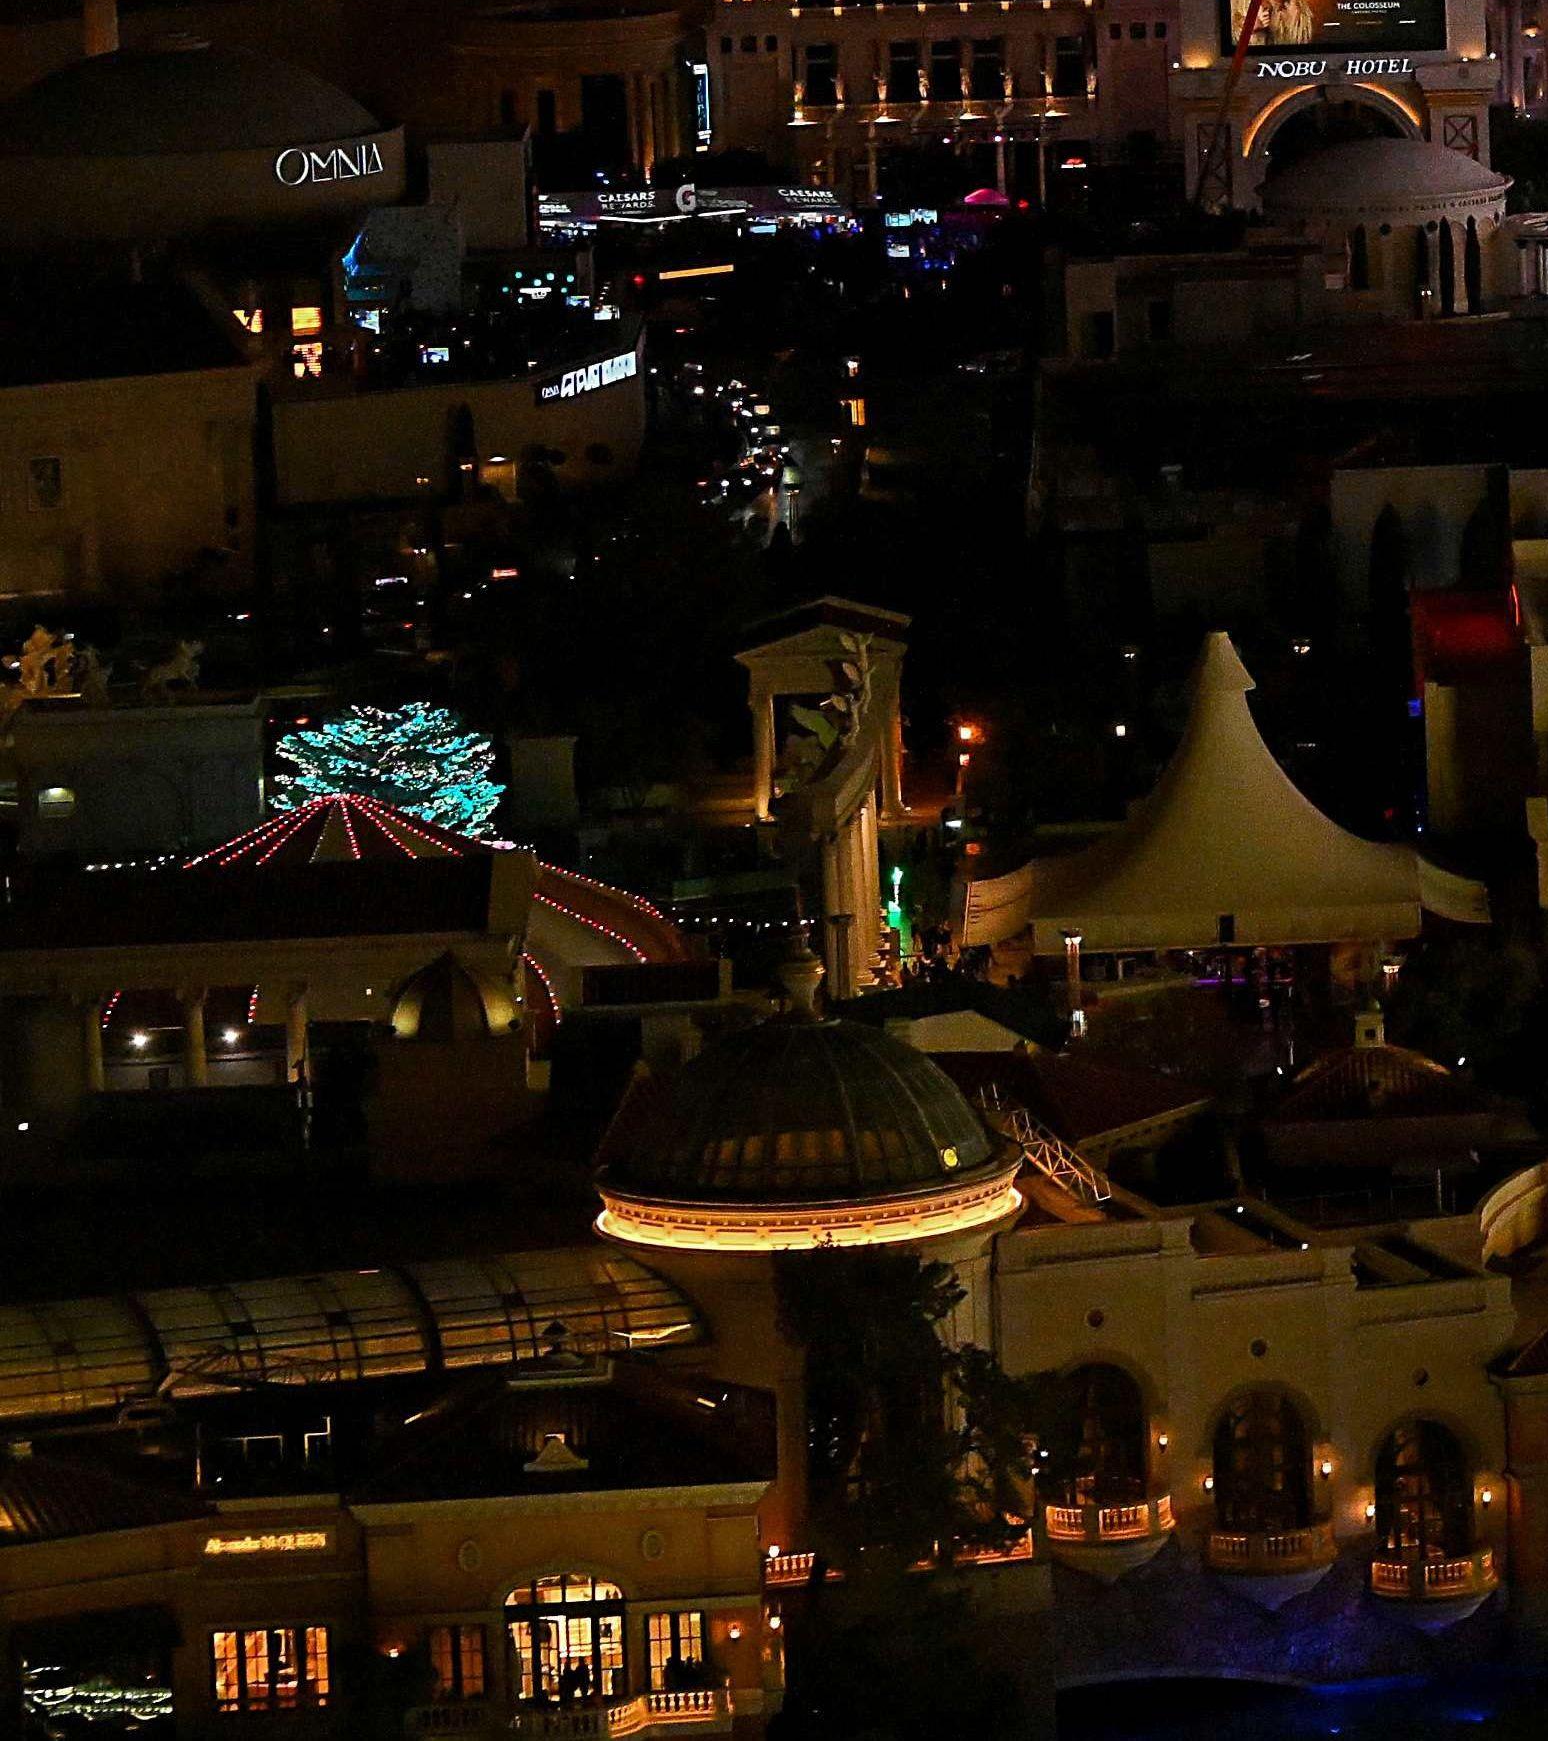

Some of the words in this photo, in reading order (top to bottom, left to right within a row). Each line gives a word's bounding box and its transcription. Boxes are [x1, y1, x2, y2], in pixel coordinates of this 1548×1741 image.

[1337, 2, 1352, 10] THE
[1353, 1, 1401, 10] COLOSSEUM
[1258, 61, 1327, 77] NOBU
[1346, 59, 1414, 75] HOTEL
[276, 143, 384, 185] OMNIA
[597, 191, 656, 203] CAESARS
[602, 202, 656, 210] REARDS
